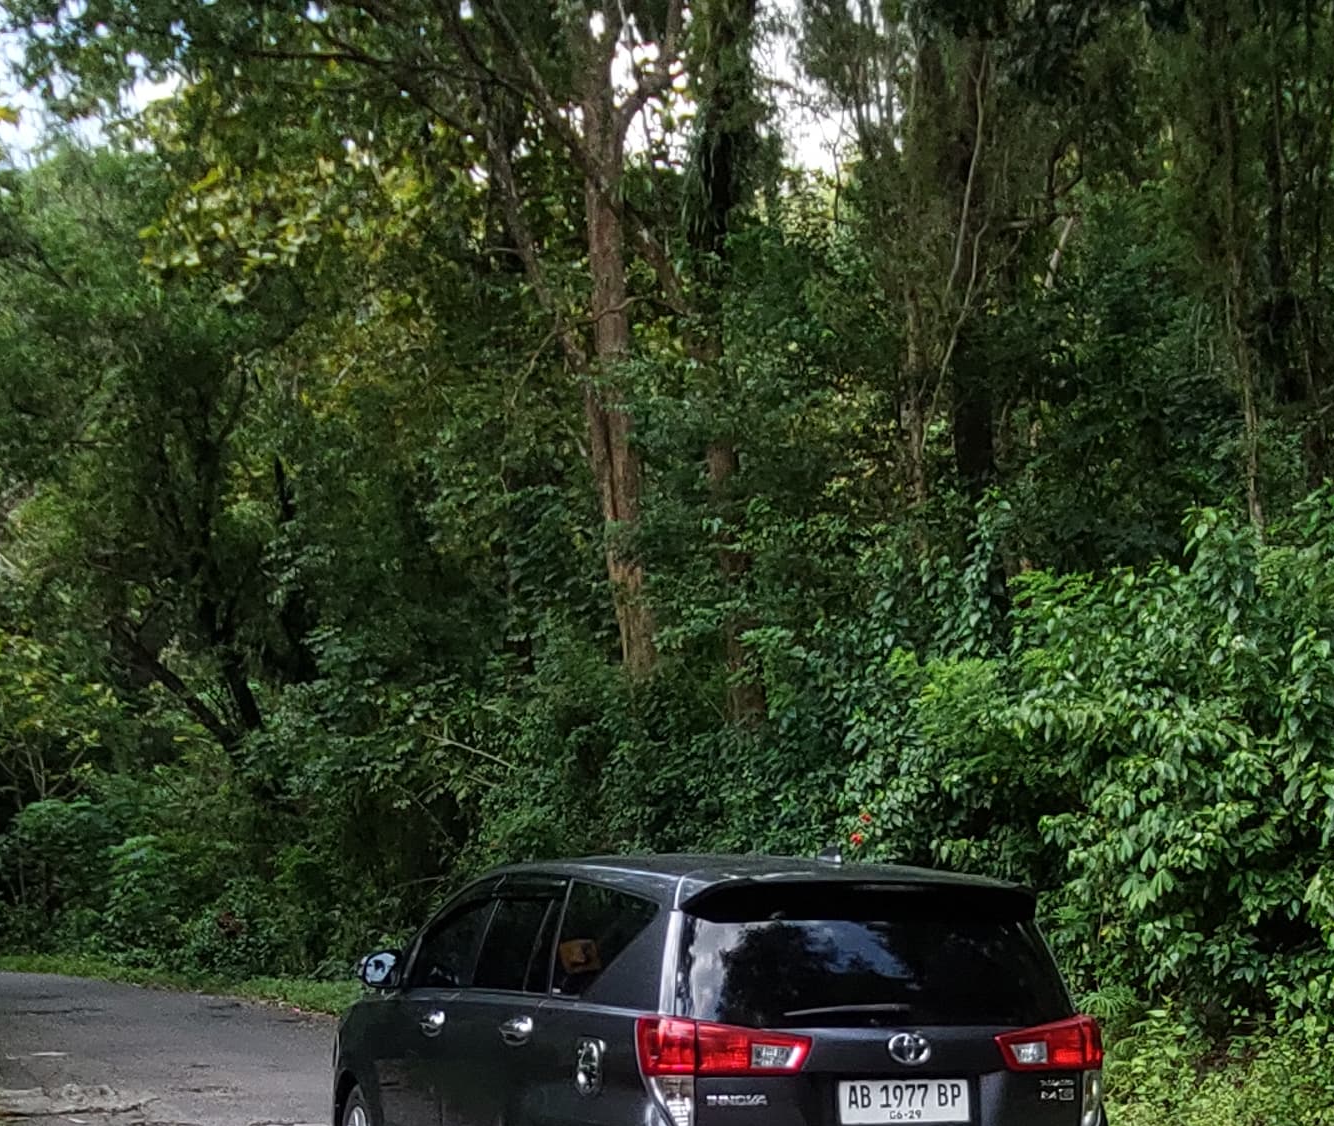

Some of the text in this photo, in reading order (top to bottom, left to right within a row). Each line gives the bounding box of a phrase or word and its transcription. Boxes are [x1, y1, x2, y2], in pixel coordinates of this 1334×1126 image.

[848, 1083, 962, 1109] AB 1977 BP
